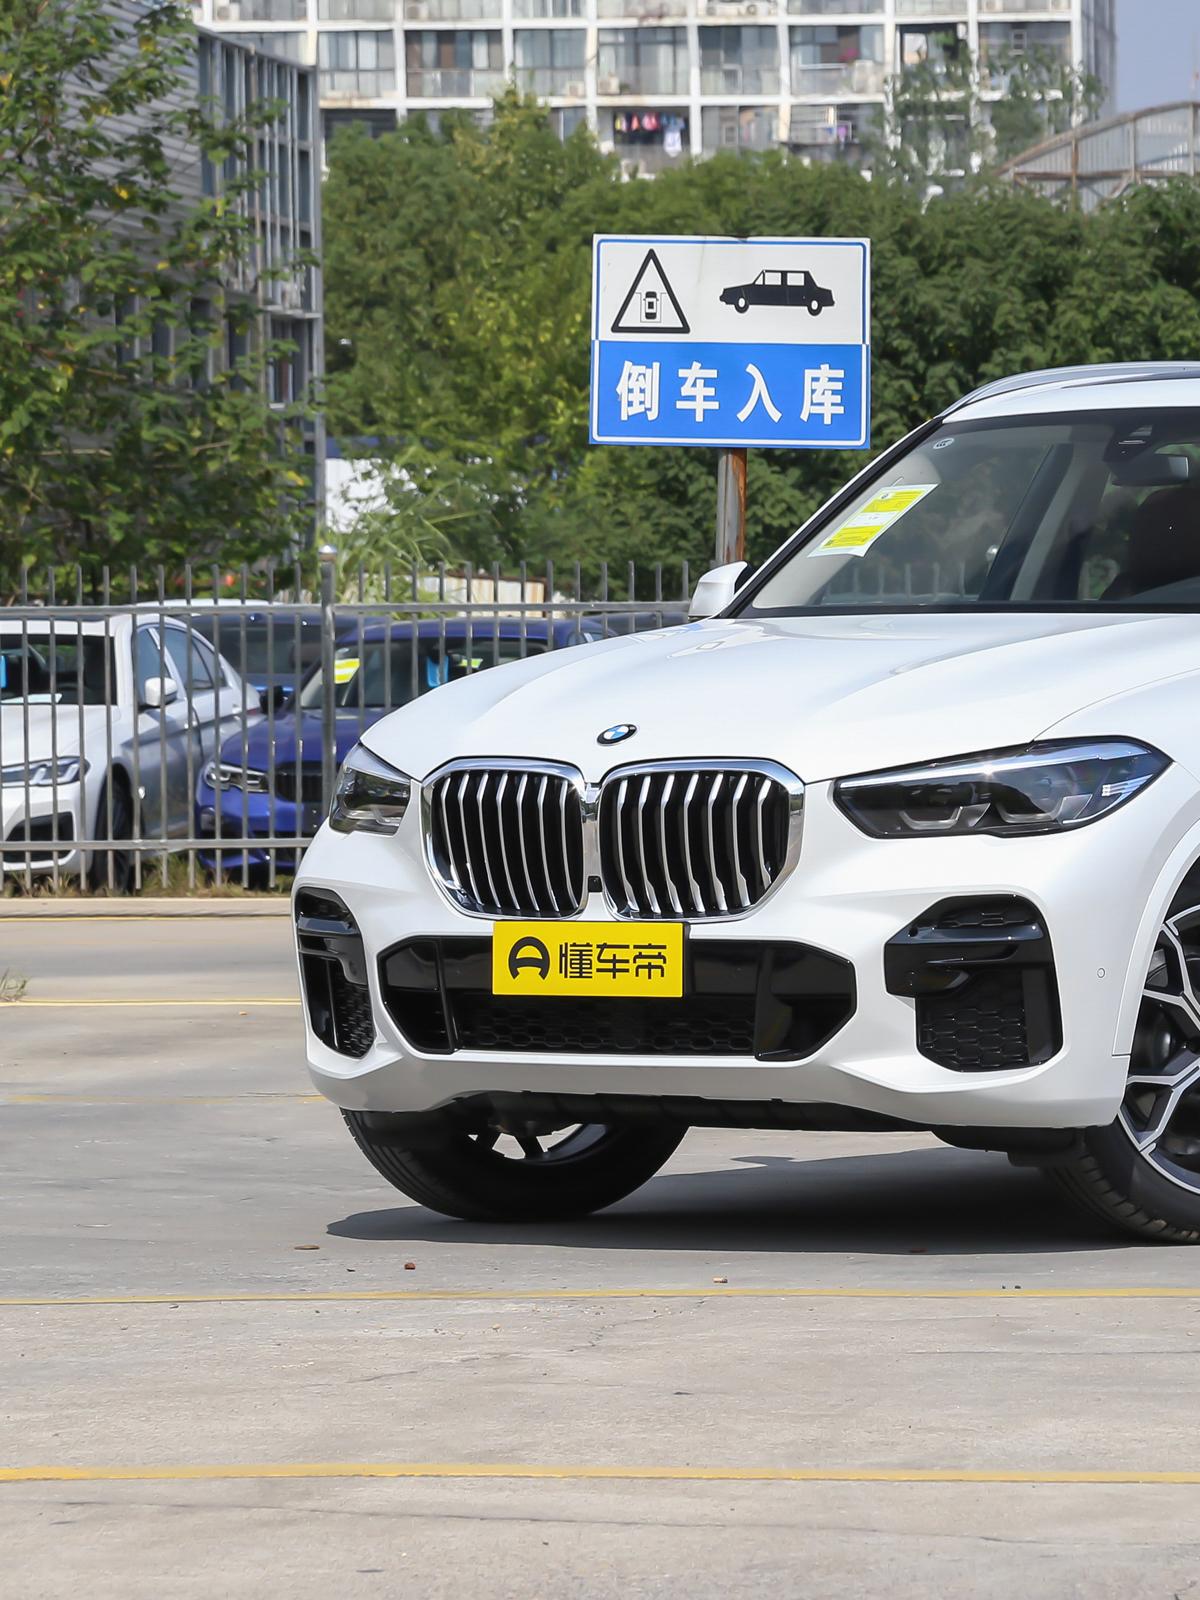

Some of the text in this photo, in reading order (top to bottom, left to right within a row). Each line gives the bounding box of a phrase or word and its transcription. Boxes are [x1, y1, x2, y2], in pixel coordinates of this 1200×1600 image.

[616, 360, 844, 424] 倒车入库
[559, 942, 667, 979] 懂车帝
